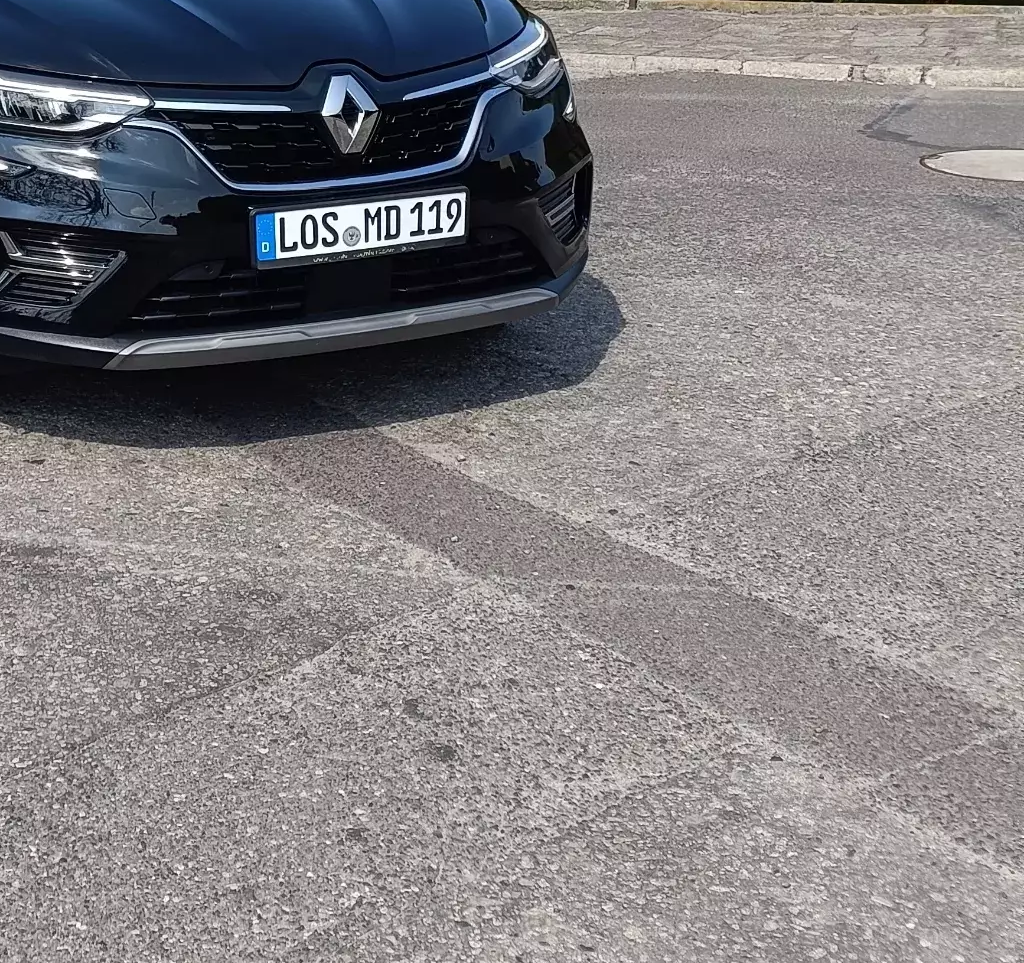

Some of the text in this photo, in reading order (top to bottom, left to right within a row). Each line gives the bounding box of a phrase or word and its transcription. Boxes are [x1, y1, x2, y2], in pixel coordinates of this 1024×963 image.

[279, 198, 462, 253] LOS MD 119
[261, 242, 270, 253] D
